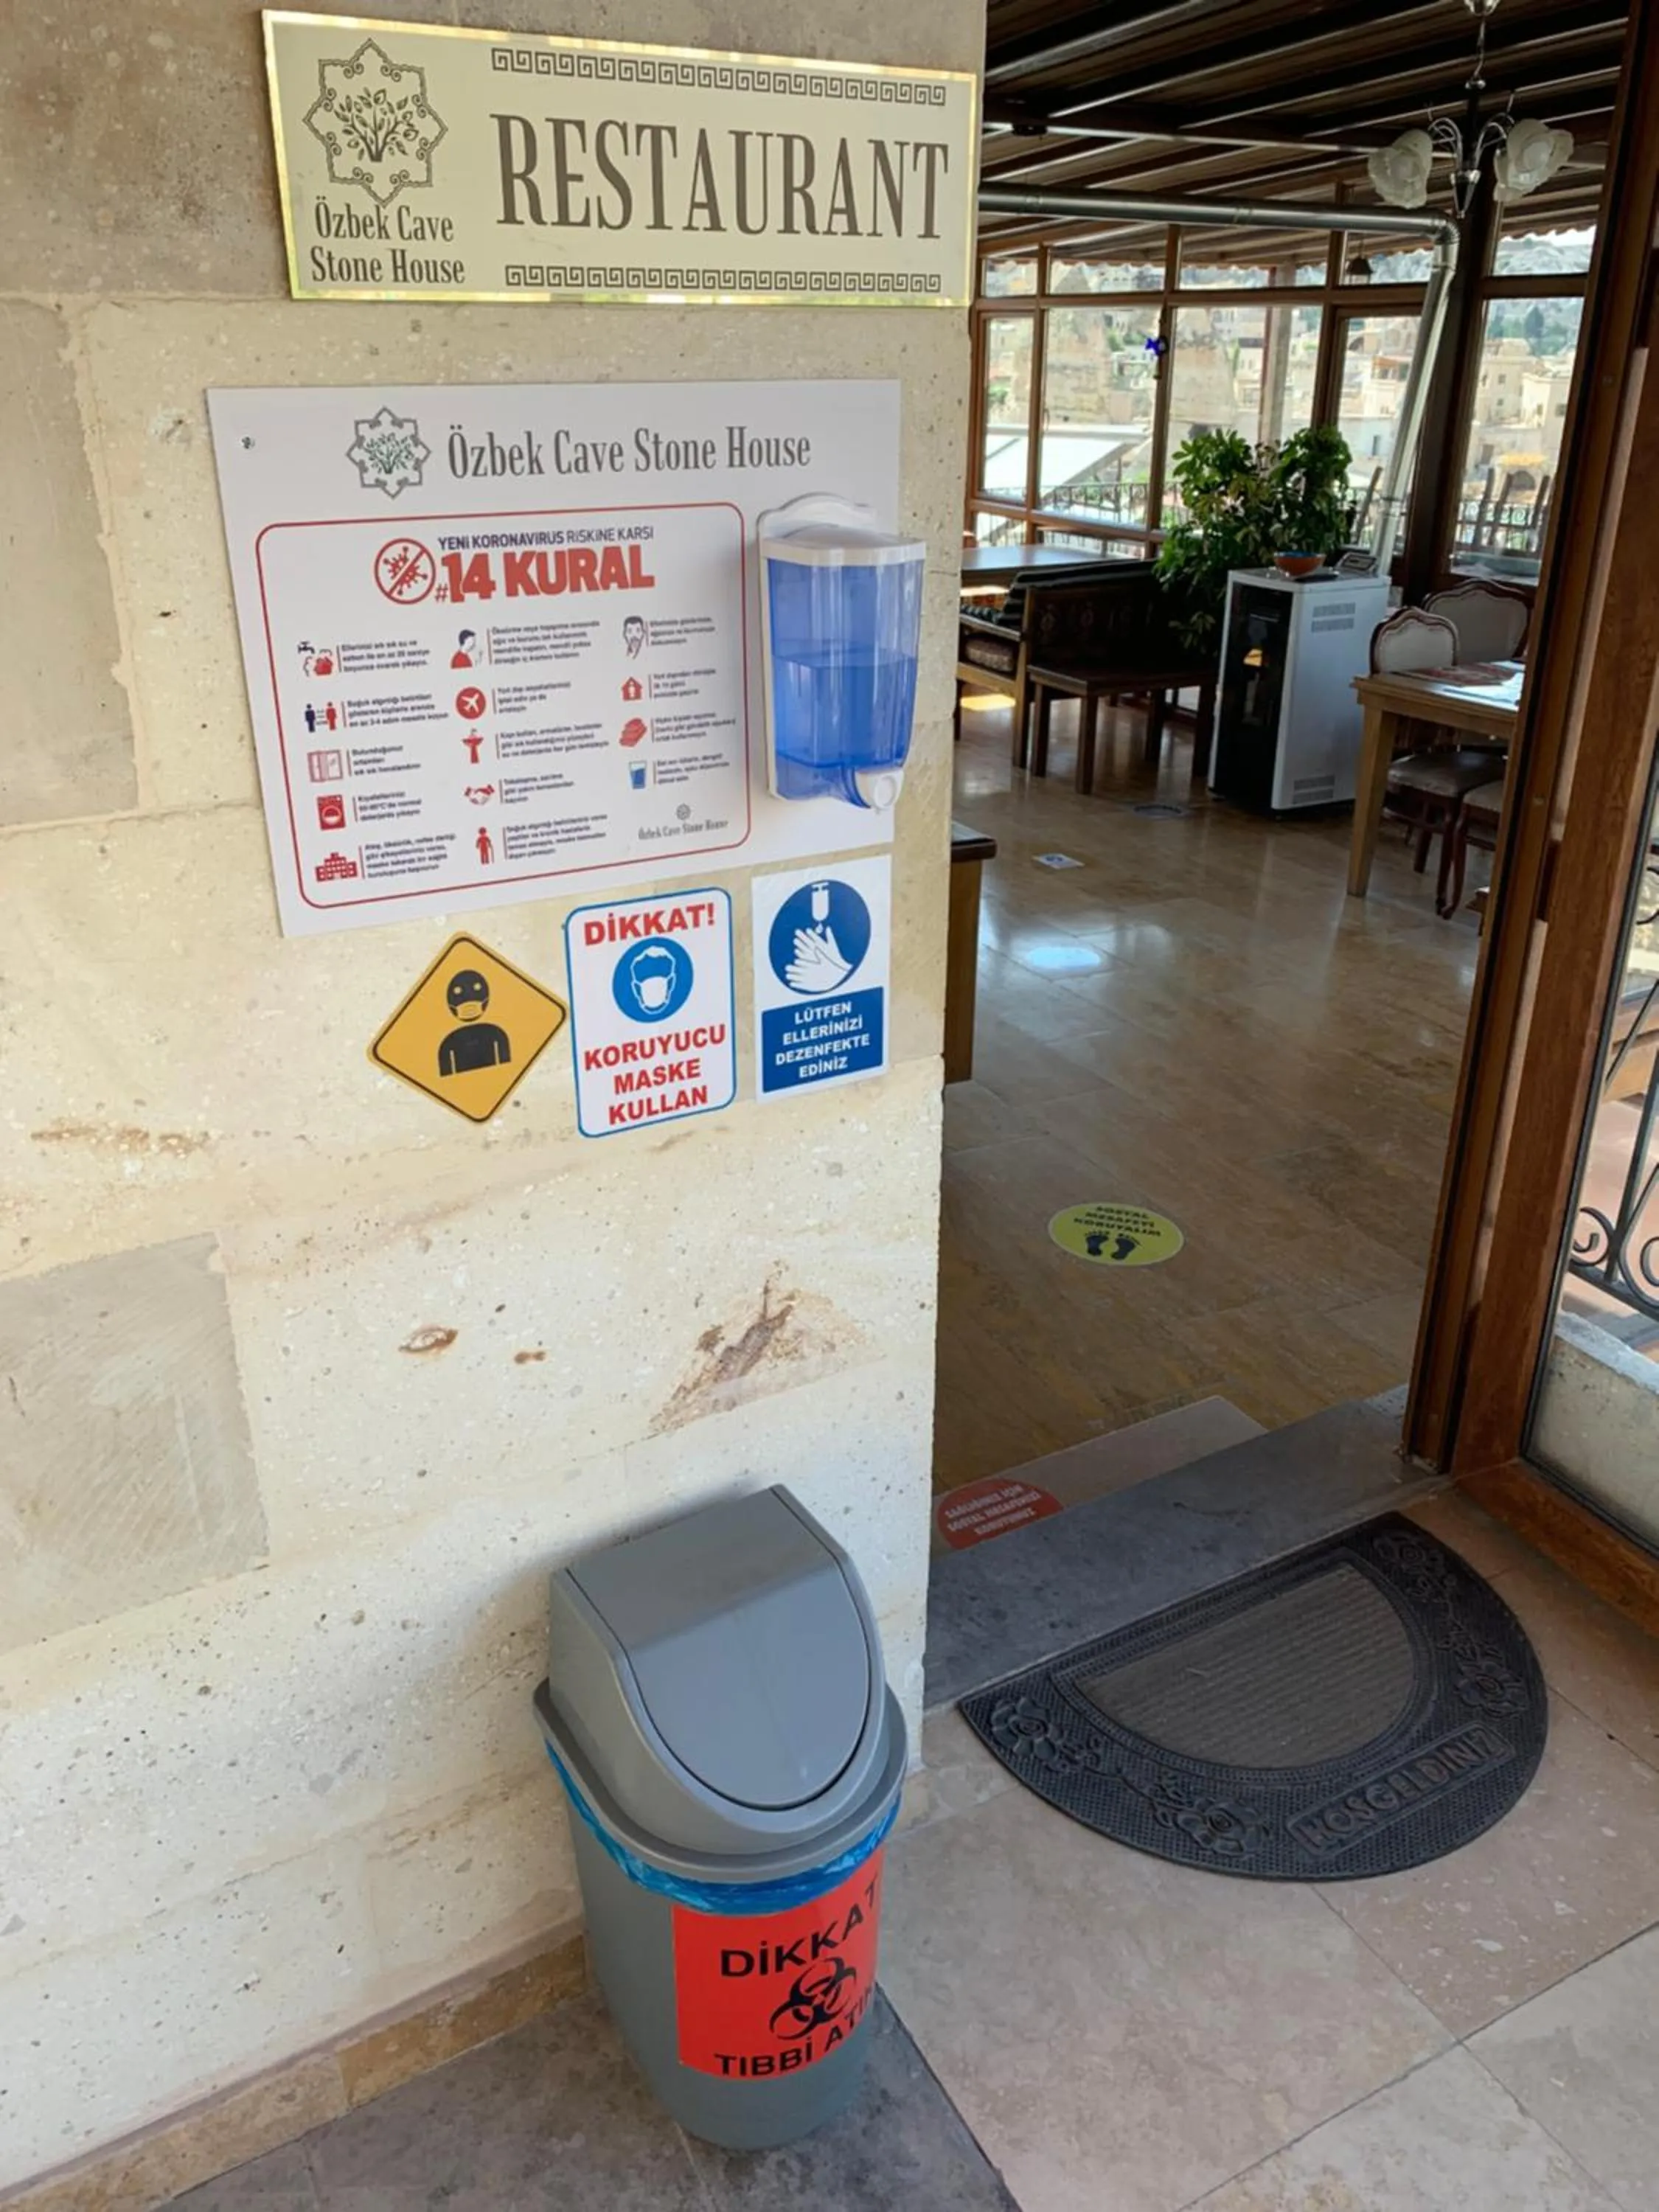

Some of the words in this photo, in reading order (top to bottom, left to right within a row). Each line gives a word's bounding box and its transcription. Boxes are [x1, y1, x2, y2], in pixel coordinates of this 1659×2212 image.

[490, 113, 949, 240] RESTAURANT
[315, 195, 391, 240] Özbek
[397, 205, 453, 242] Cave
[310, 246, 383, 282] Stone
[387, 248, 465, 283] House
[448, 425, 544, 479] Özbek
[554, 430, 625, 474] Cave
[634, 428, 716, 472] Stone
[725, 426, 811, 469] House
[504, 544, 655, 597] KURAL
[584, 902, 714, 945] DİKKAT!
[795, 1001, 852, 1025] LÜTFEN
[584, 1024, 726, 1071] KORUYUCU
[775, 1033, 870, 1065] DEZENFEKTE
[799, 1056, 848, 1078] EDİNİZ
[613, 1059, 701, 1095] MASKE
[608, 1085, 708, 1125] KULLAN
[720, 1871, 878, 1978] DİKKAT
